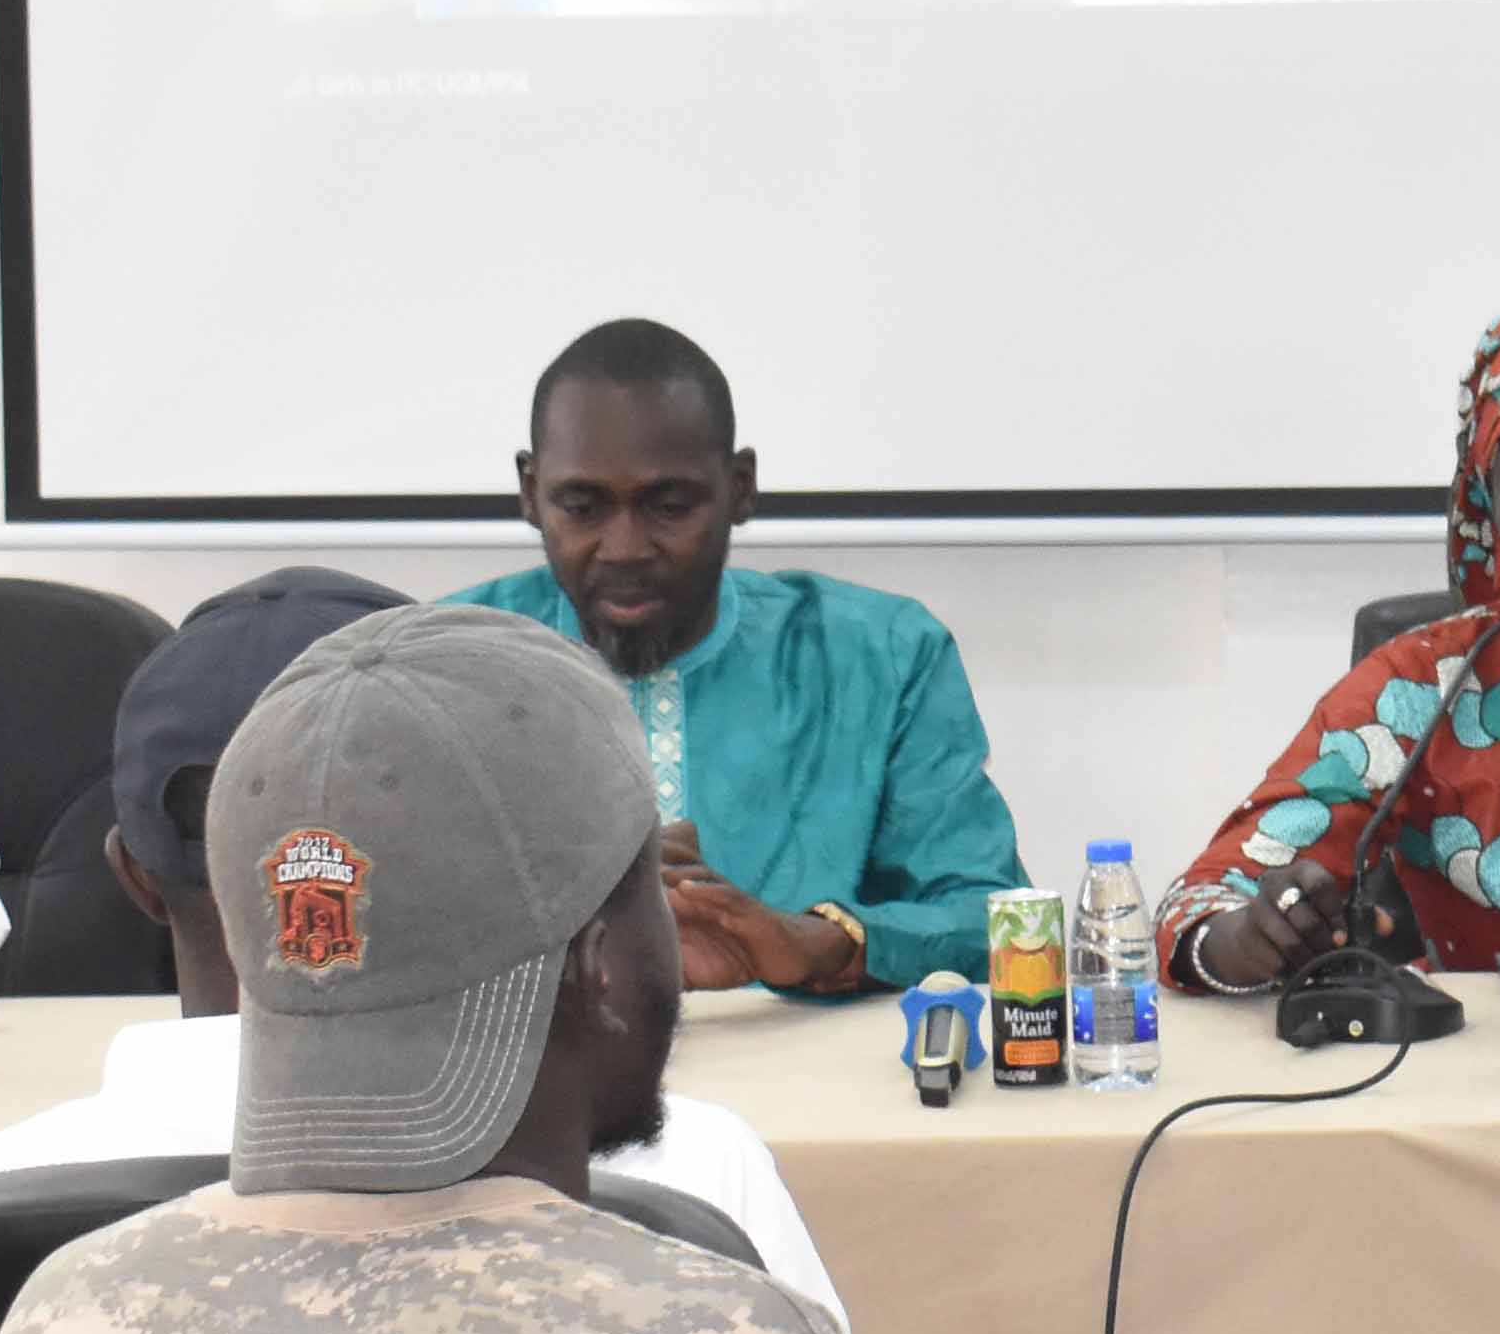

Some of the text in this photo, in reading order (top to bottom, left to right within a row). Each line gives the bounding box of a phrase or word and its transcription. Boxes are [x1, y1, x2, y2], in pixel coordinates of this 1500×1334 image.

[285, 846, 343, 862] WORLD
[276, 860, 355, 884] CHAMPIONS
[1003, 1006, 1058, 1023] Minute
[1011, 1020, 1052, 1038] Maid
